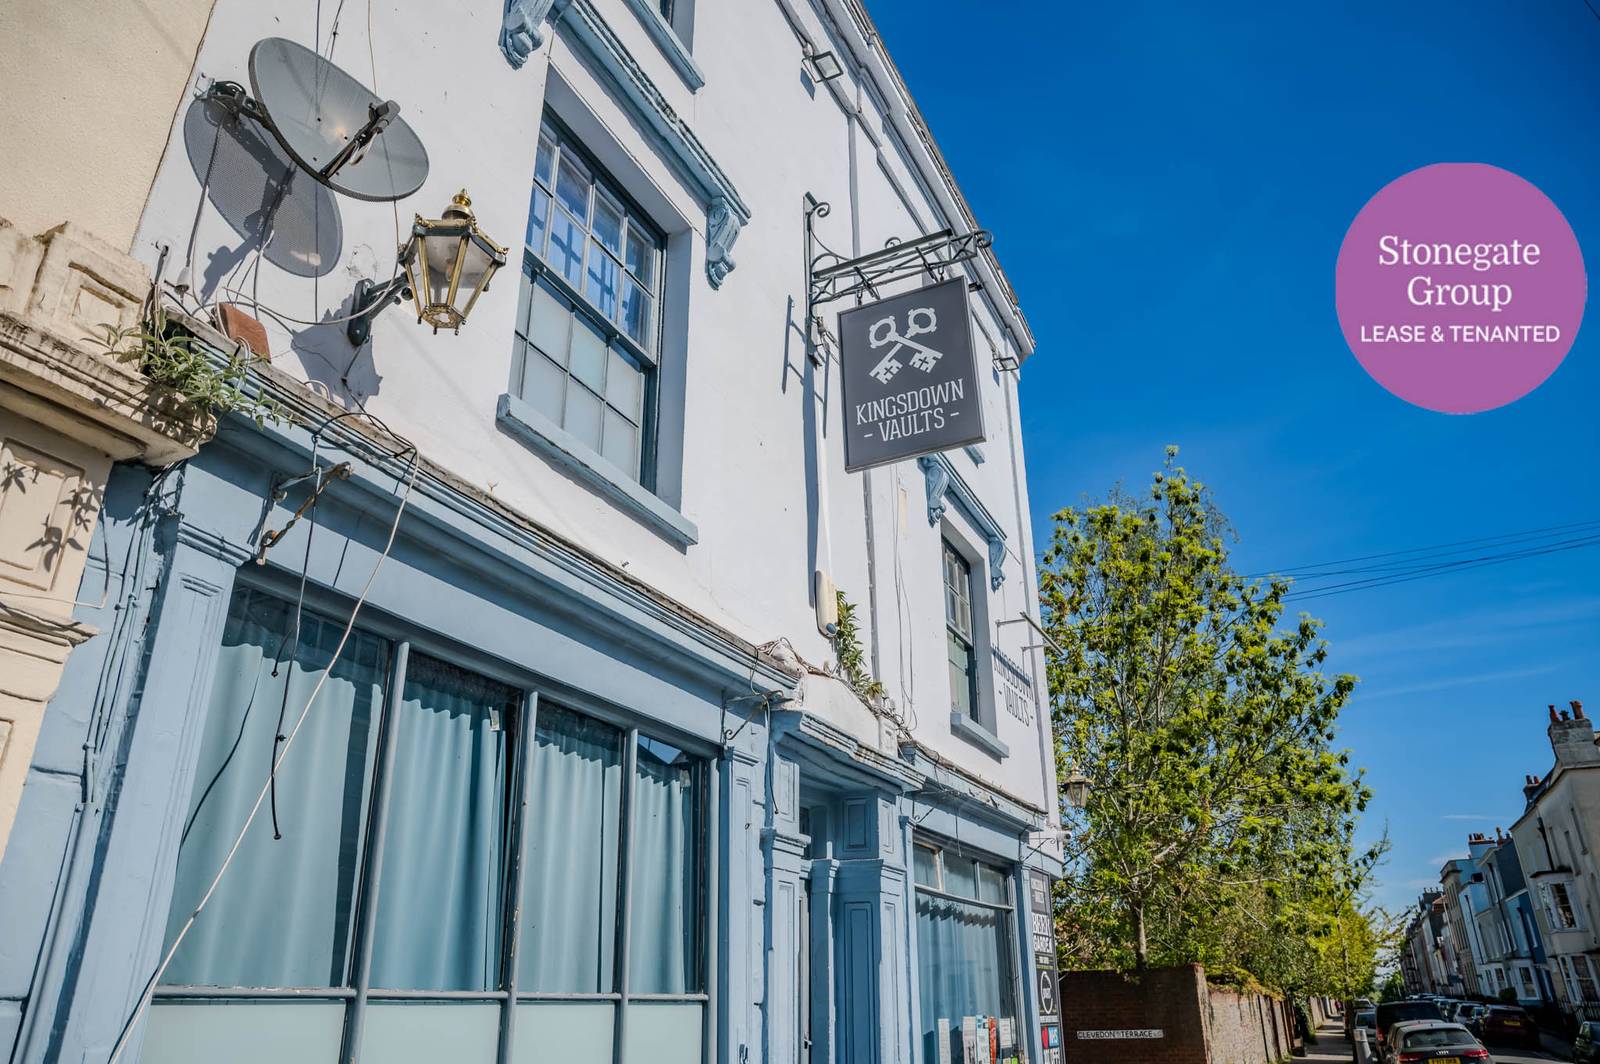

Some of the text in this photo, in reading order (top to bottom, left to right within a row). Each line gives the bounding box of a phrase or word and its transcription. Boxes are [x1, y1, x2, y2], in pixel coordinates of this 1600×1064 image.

[856, 378, 964, 425] KINGSDOWN
[878, 408, 945, 442] VAULTS
[1077, 1031, 1116, 1039] CLEVEDON
[1120, 1030, 1153, 1038] TERRACE
